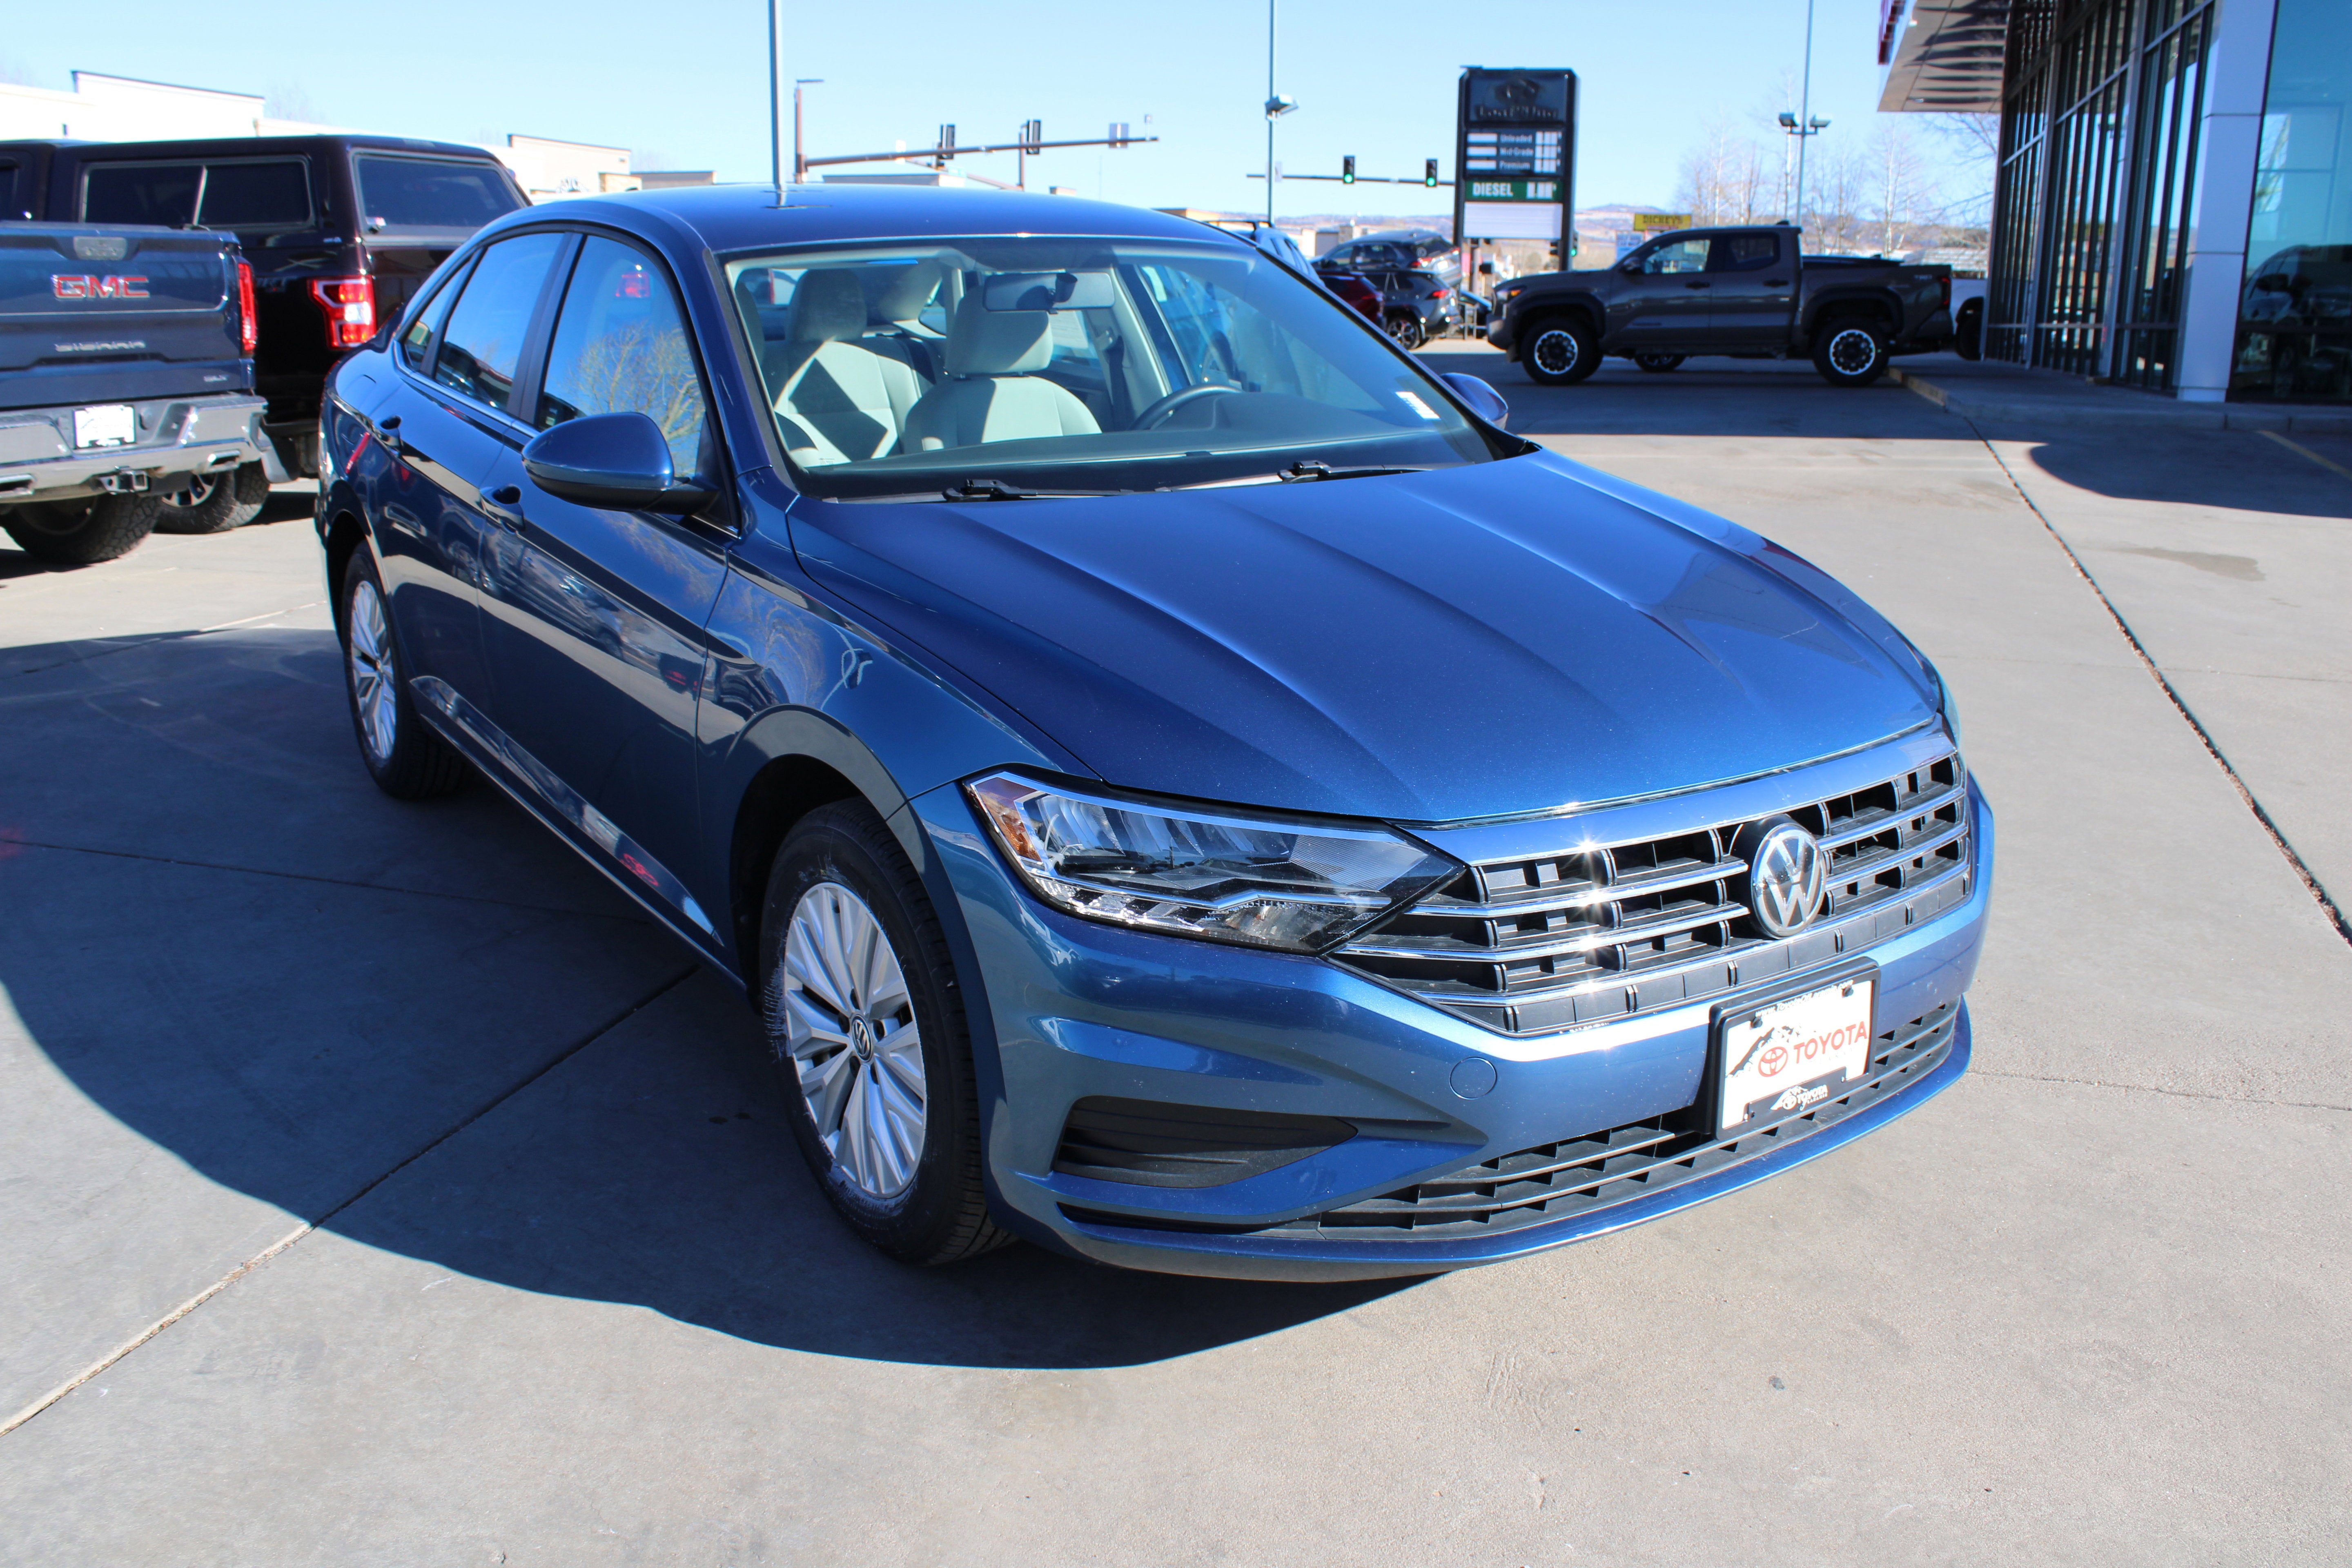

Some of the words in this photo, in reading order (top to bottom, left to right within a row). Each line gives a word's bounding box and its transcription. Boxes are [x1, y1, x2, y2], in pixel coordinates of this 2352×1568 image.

[1472, 182, 1513, 197] DIESEL
[53, 274, 150, 299] GMC
[1793, 1021, 1867, 1064] TOYOTA
